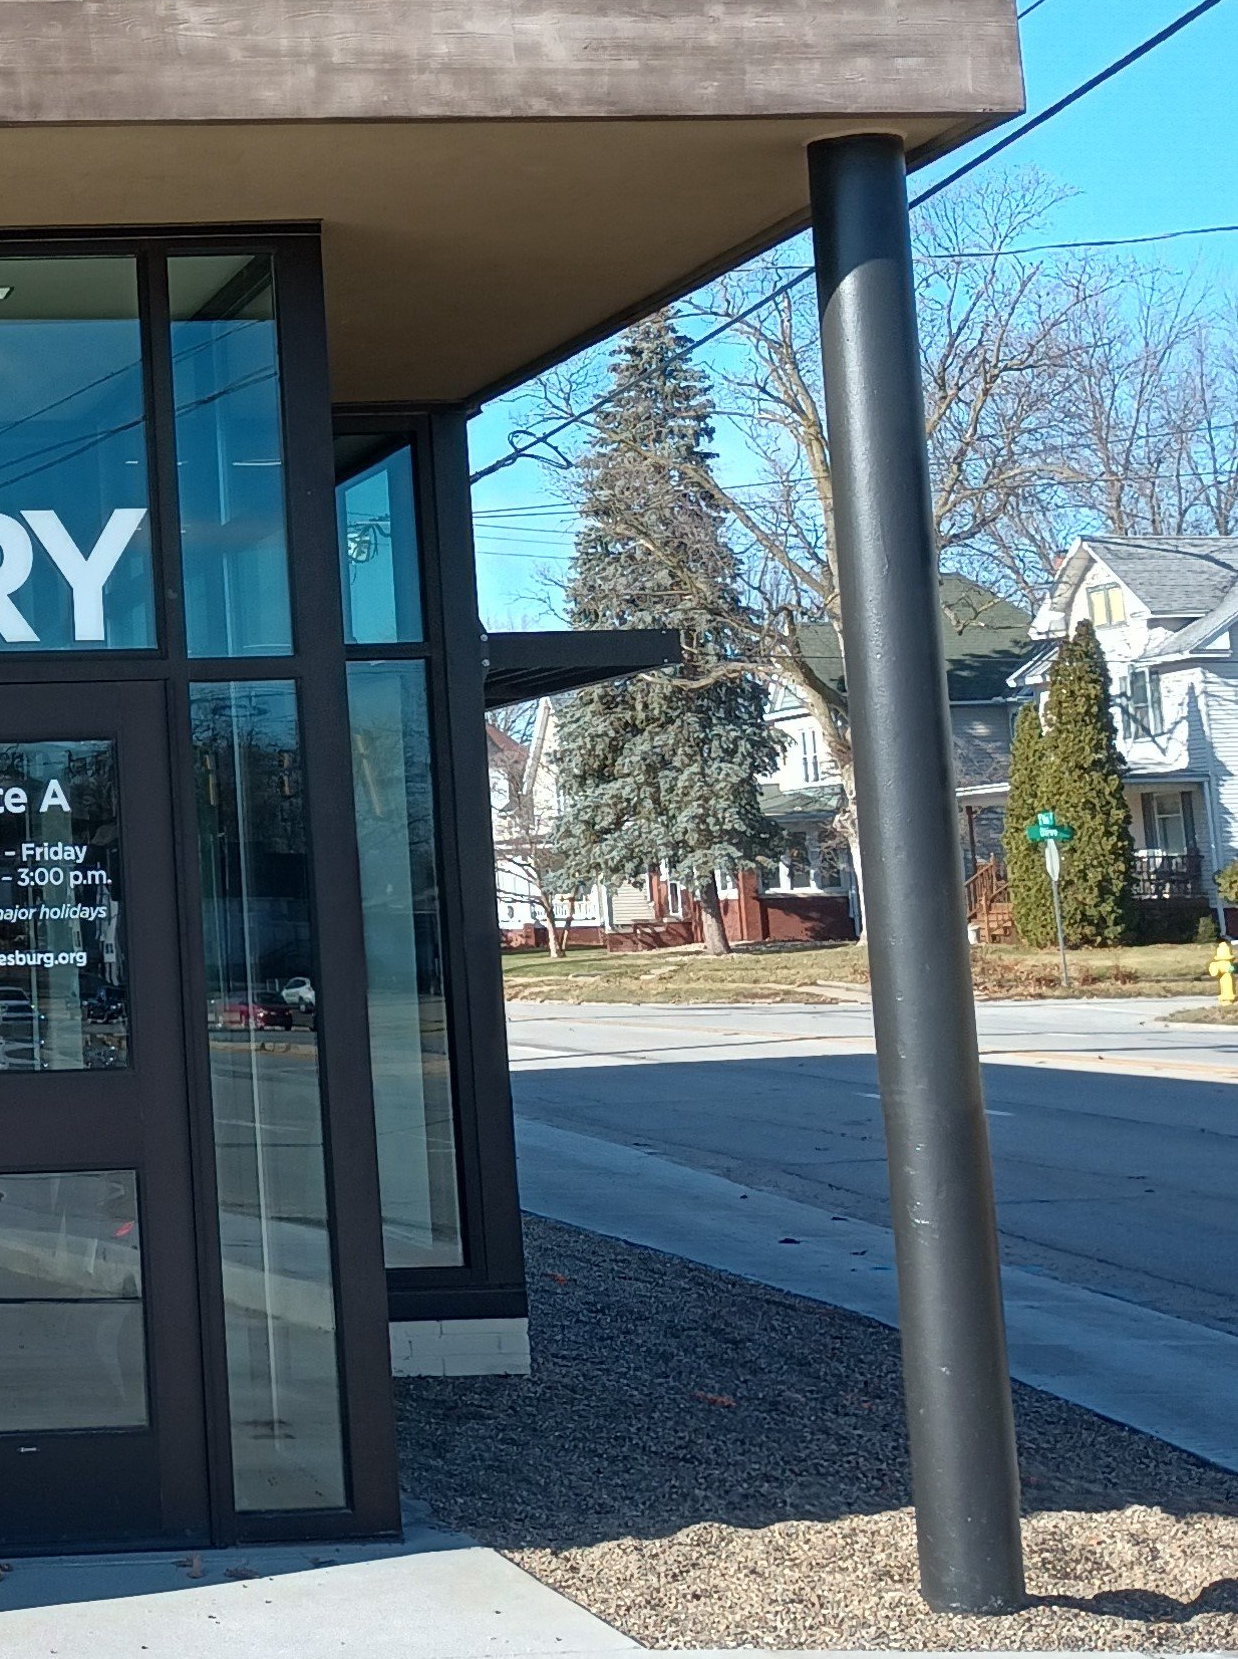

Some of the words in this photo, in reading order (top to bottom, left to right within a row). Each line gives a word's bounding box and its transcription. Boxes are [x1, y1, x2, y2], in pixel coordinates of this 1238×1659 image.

[39, 778, 72, 813] A
[21, 842, 88, 864] Friday
[17, 867, 64, 886] 3:00
[69, 871, 113, 888] p.m.
[39, 904, 107, 922] holidays
